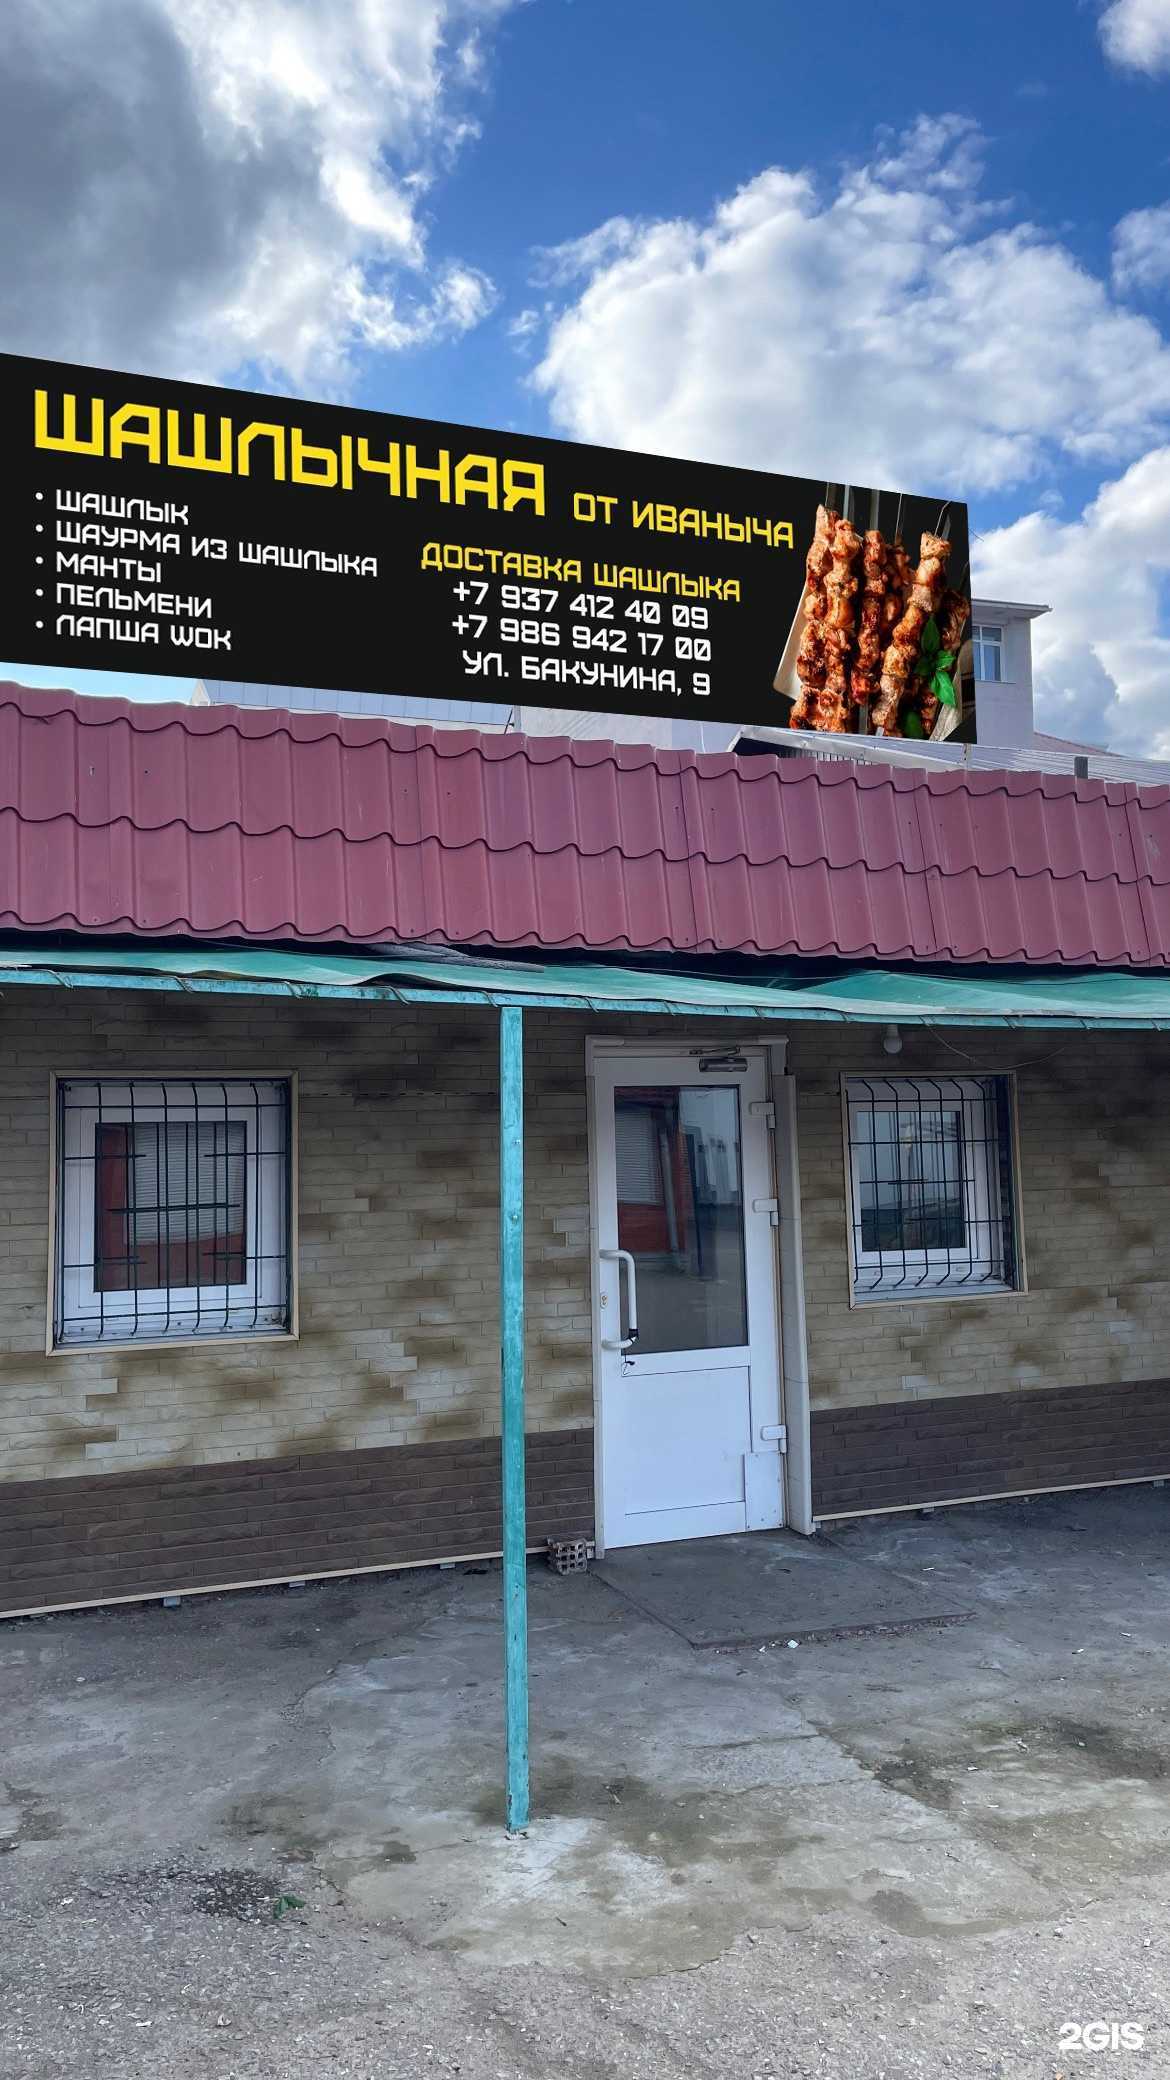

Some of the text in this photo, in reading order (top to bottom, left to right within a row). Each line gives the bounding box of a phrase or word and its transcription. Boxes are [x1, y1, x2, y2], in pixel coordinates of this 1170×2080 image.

[35, 390, 793, 549] ШАШЛЫЧНАЯ ОТ ИВАНЫЧА
[57, 489, 188, 525] ШАШЛЫК
[57, 521, 377, 577] ШАУРМА ИЗ ШАШЛЫКА
[57, 552, 161, 582] МАНТЫ
[421, 543, 740, 602] ДОСТАВКА ШАШЛЫКА
[57, 583, 211, 618] ПЕЛЬМЕНИ
[453, 581, 708, 629] +7 937 412 40 09
[57, 615, 158, 643] ЛАПША
[452, 614, 711, 661] +7 986 942 17 00
[463, 650, 710, 696] УЛ. БАКУНИНА, 9
